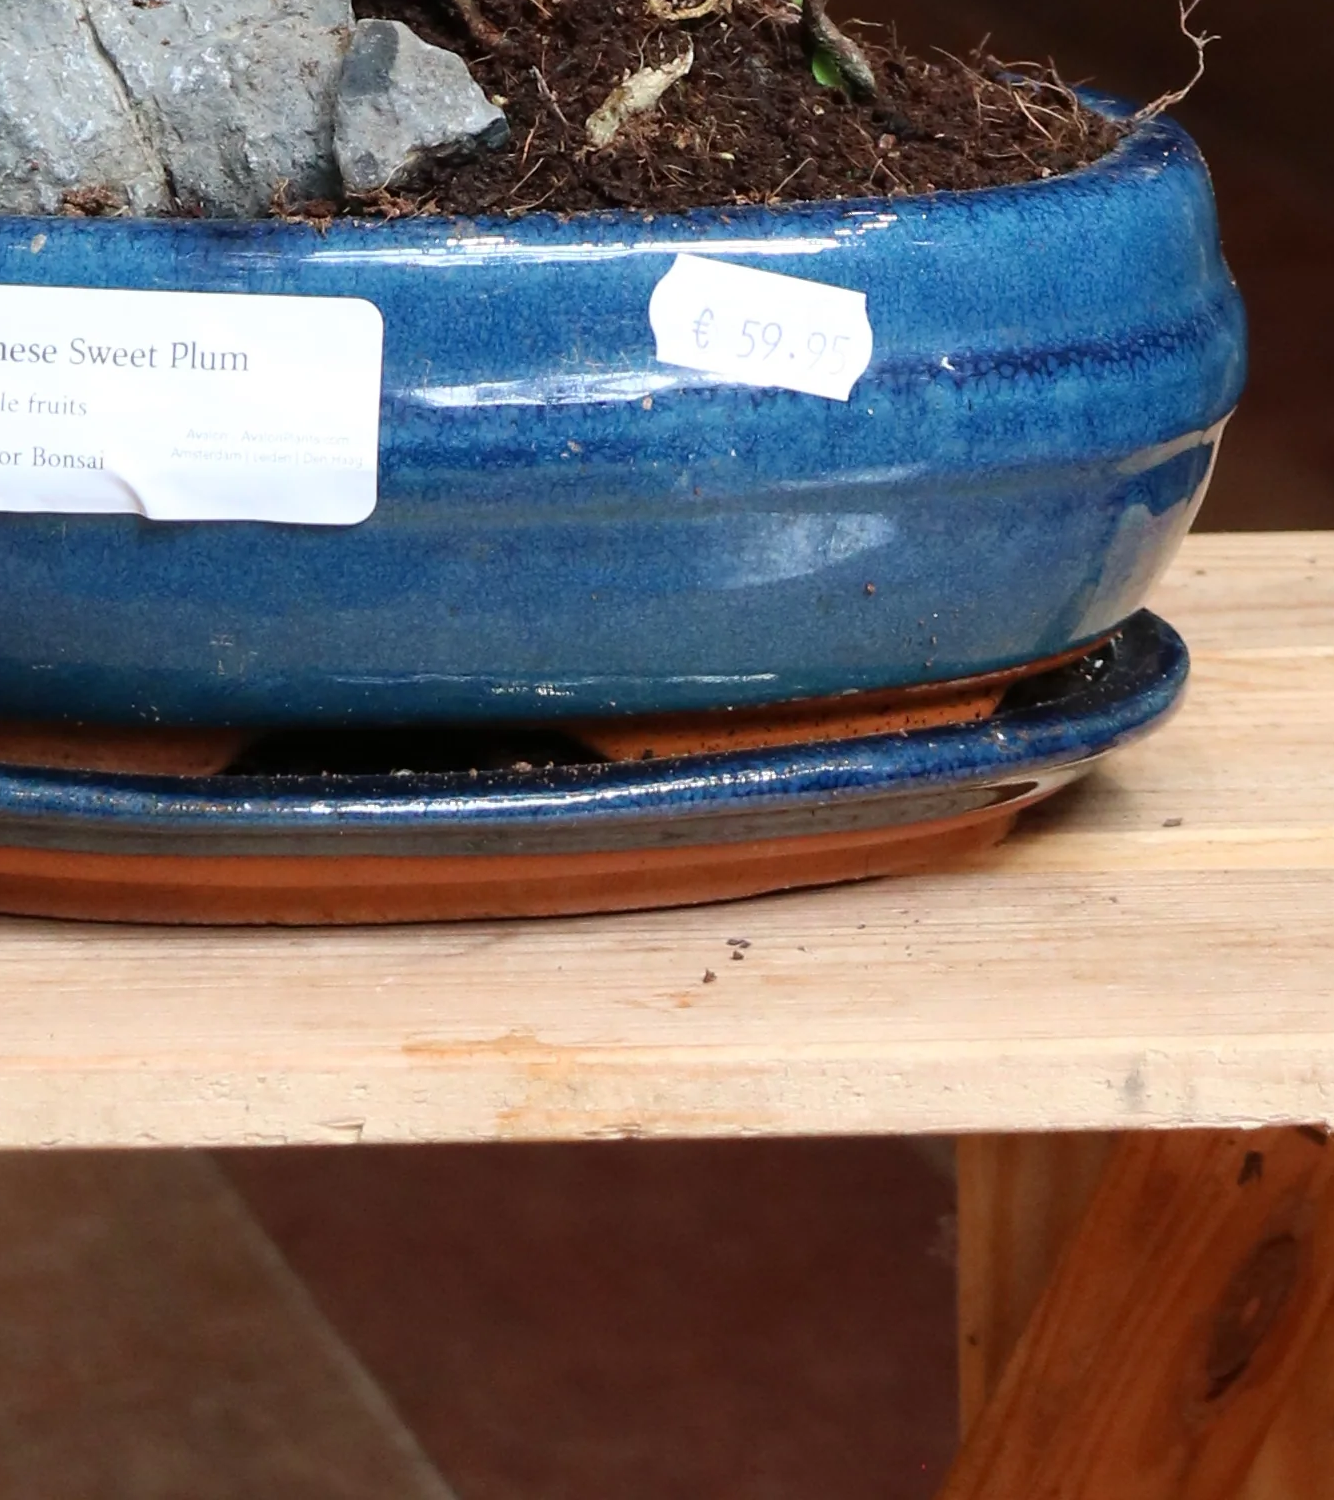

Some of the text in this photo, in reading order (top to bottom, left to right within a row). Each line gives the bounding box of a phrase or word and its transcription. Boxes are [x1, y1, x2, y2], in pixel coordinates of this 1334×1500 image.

[69, 337, 158, 368] Sweet
[170, 340, 249, 372] Plum
[692, 307, 851, 375] € 59.95
[28, 392, 87, 417] fruits
[32, 446, 105, 470] Bonsai
